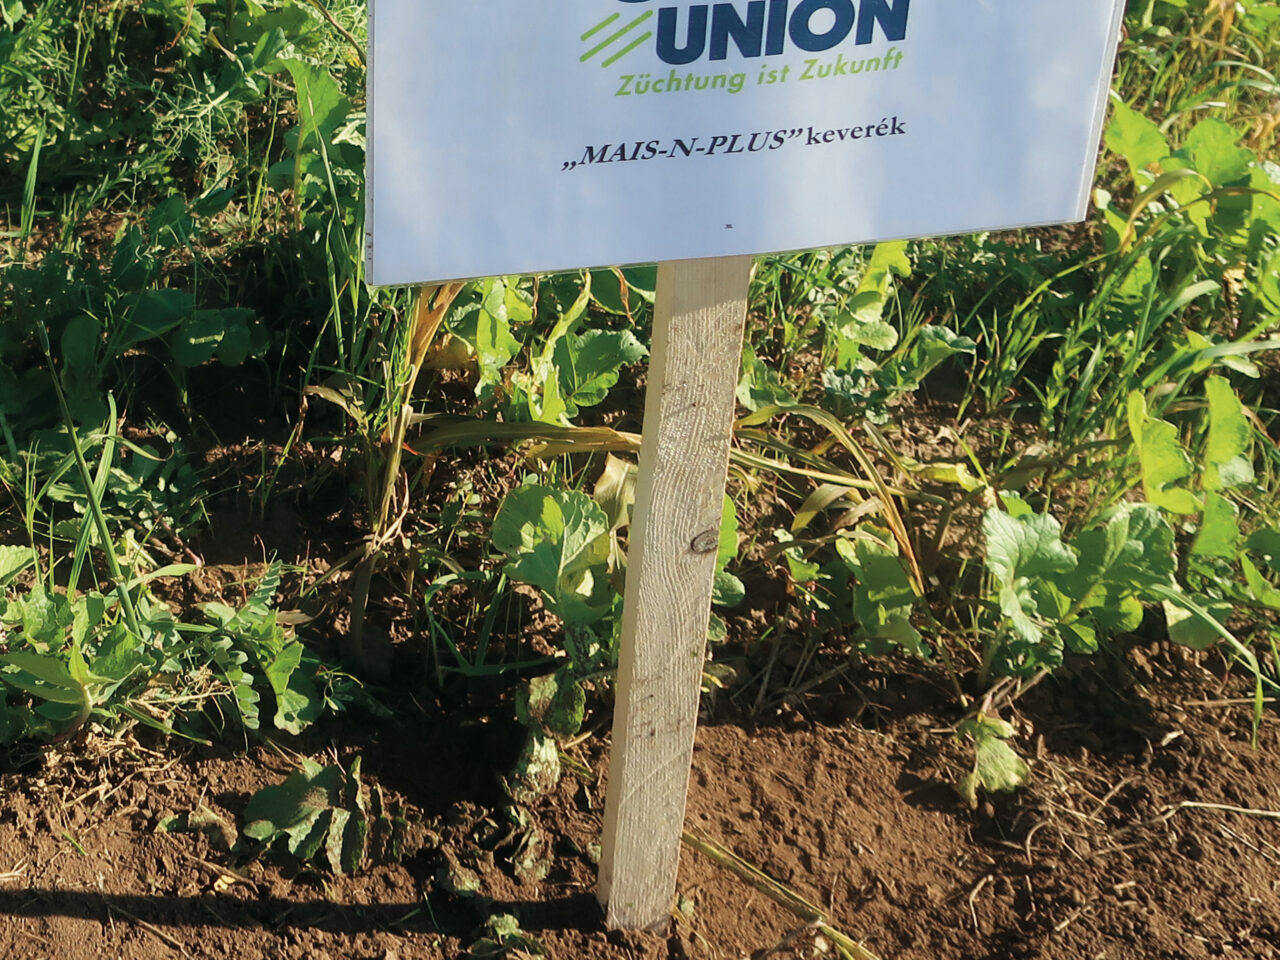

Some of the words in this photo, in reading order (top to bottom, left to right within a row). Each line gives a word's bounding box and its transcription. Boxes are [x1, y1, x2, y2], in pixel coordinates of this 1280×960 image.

[614, 68, 746, 96] Züchtung
[757, 63, 791, 85] ist
[798, 47, 904, 81] Zukunft
[805, 115, 908, 146] keverék
